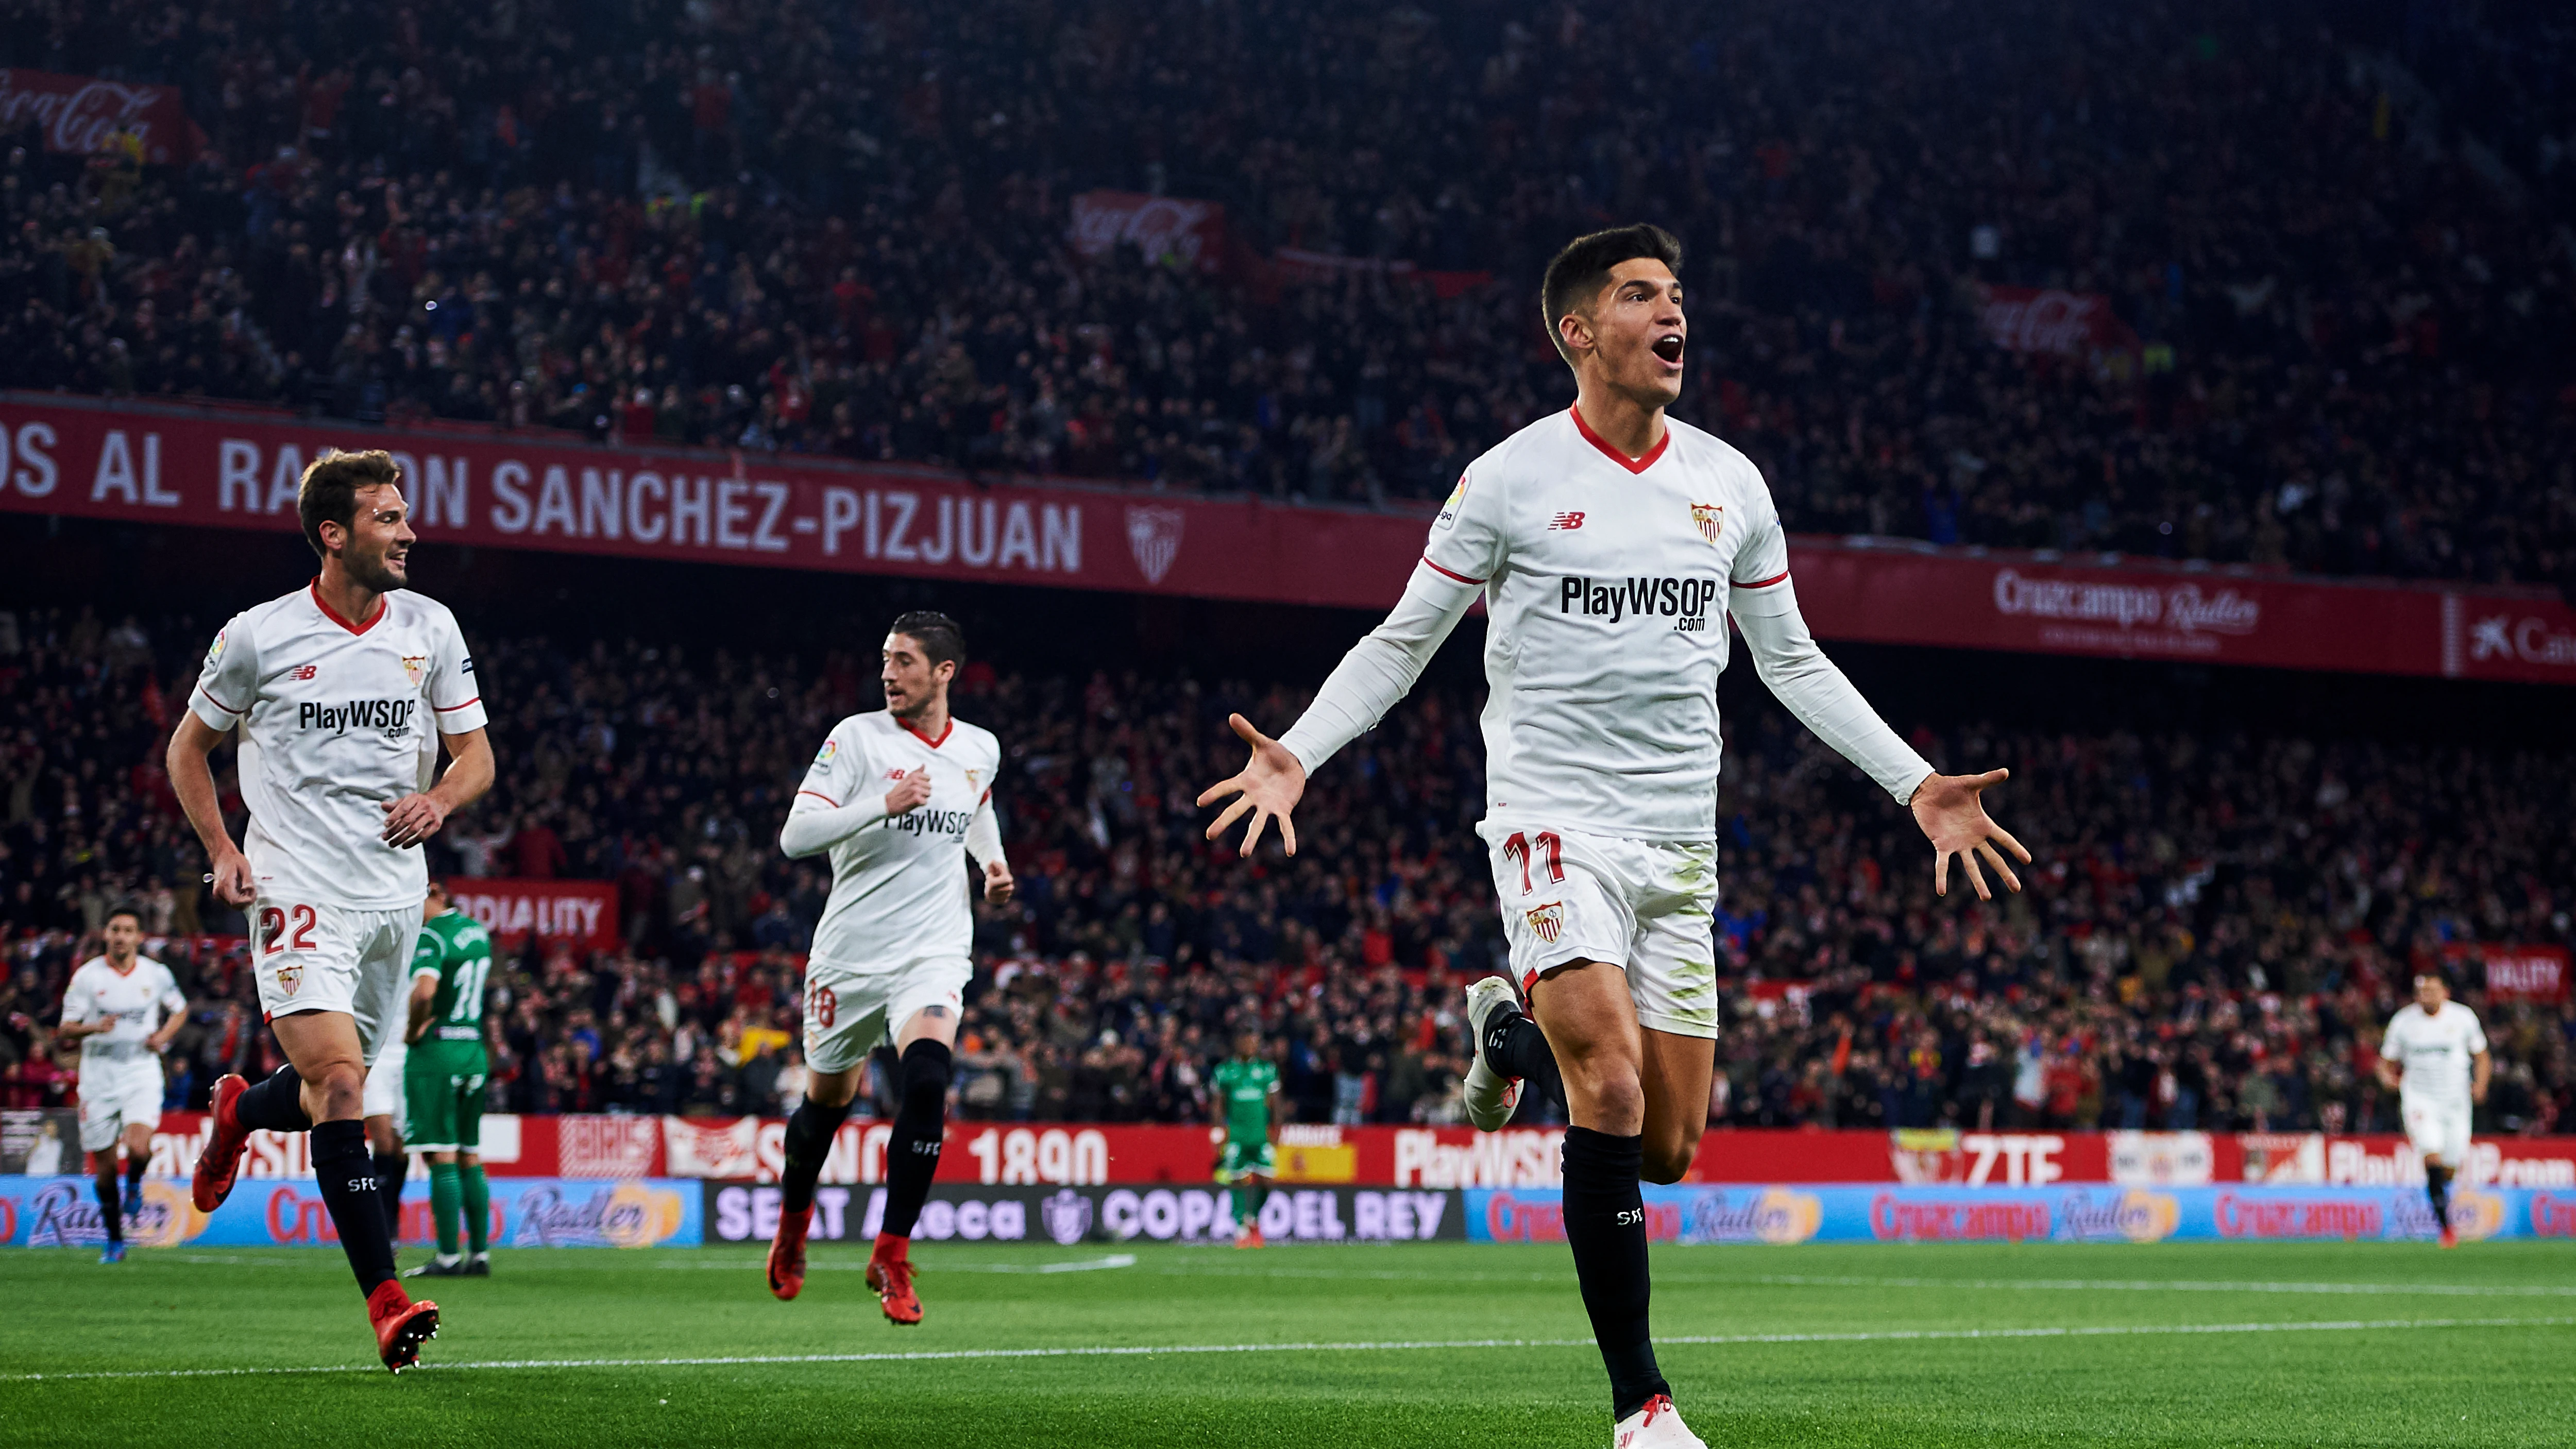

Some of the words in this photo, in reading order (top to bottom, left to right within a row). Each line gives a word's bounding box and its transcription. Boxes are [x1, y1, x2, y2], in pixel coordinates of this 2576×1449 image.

[0, 419, 59, 498] S
[90, 430, 181, 507] AL
[219, 438, 470, 529] RAON
[490, 458, 1082, 573] SANCHEZ-PIZJUAN
[1561, 576, 1716, 624] PlayWSOP
[1673, 617, 1705, 632] .com
[1992, 567, 2162, 631] Cruzcampo
[2514, 616, 2576, 666] Cai
[299, 699, 415, 735] PlayWSOP
[1503, 831, 1565, 896] 11
[260, 904, 316, 957] 22
[348, 1177, 378, 1192] SFC
[517, 1185, 648, 1243] Radler
[860, 1186, 1027, 1242] Aeca
[1101, 1188, 1236, 1240] COPA
[1353, 1189, 1448, 1241] REY
